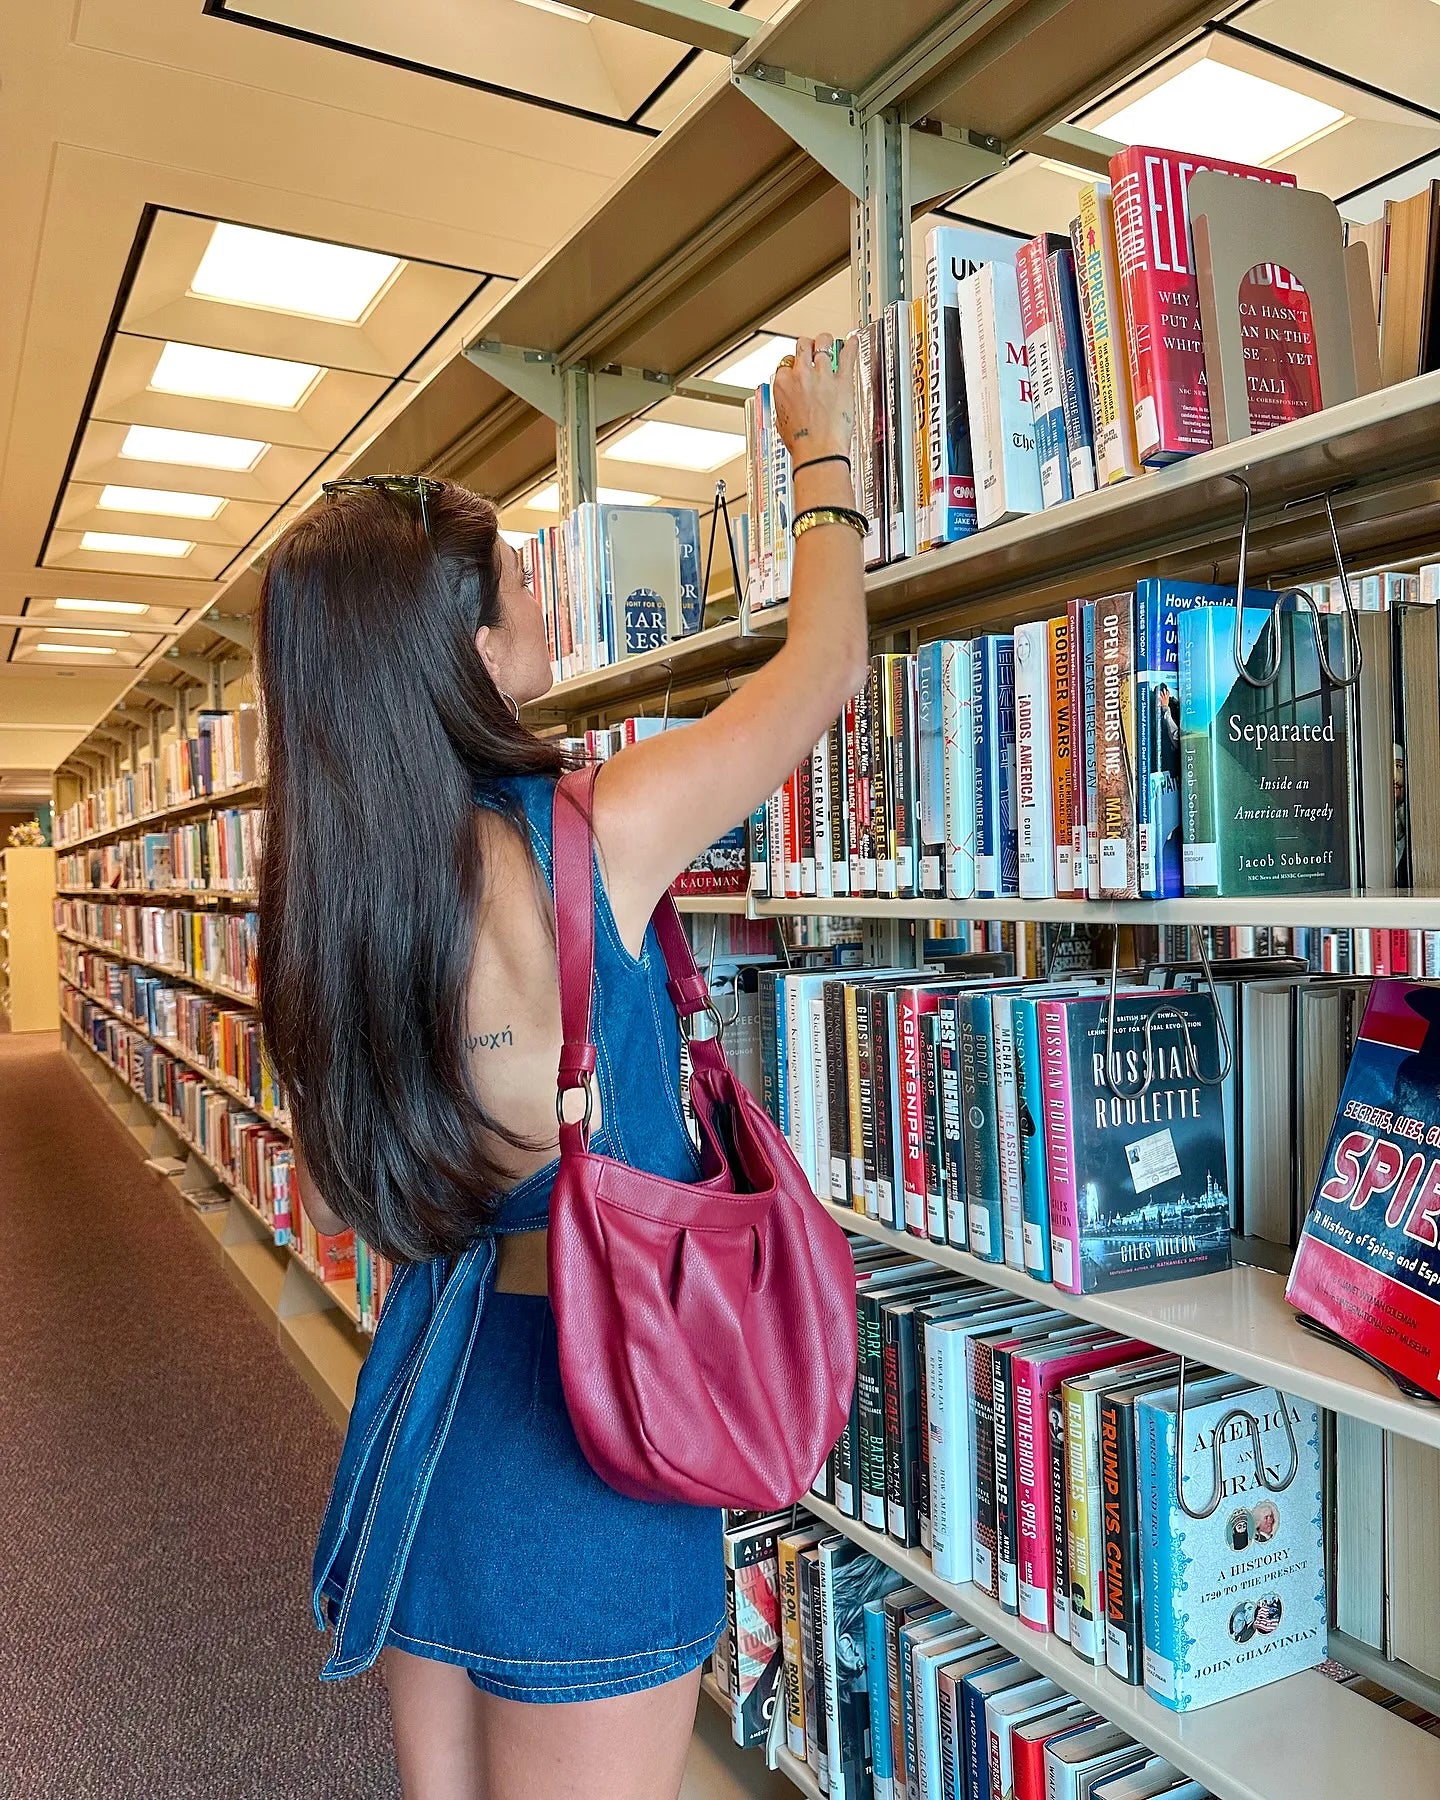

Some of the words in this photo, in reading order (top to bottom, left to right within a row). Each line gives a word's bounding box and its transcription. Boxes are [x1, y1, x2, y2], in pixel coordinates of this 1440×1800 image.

[1018, 257, 1033, 329] O'DONNELL
[1086, 250, 1110, 338] REPRESENT
[1158, 291, 1190, 308] WHY
[1161, 314, 1188, 329] PUT
[1261, 305, 1308, 323] HASN'T
[1265, 328, 1280, 340] IN
[1283, 330, 1312, 345] THE
[926, 256, 943, 474] UNPRECEDENTED
[1028, 343, 1038, 377] WITH
[1040, 342, 1053, 396] PLAYING
[1286, 352, 1313, 366] YET
[1032, 381, 1041, 411] FIRE
[1066, 368, 1076, 392] HOW
[1069, 394, 1079, 417] THE
[1012, 432, 1035, 451] The
[1072, 417, 1083, 445] HELL
[953, 517, 970, 526] JAKE
[1165, 593, 1193, 608] How
[1194, 595, 1234, 608] Should
[1103, 614, 1119, 662] OPEN
[1055, 626, 1068, 701] BORDER
[1085, 652, 1095, 673] WE
[1184, 641, 1196, 715] Separated
[920, 666, 933, 722] Lucky
[972, 650, 984, 745] ENDPAPERS
[1085, 675, 1095, 700] ARE
[1103, 664, 1121, 744] BORDERS
[873, 721, 881, 761] GREEN
[1057, 706, 1071, 759] WARS
[1086, 704, 1096, 738] HERE
[1228, 714, 1336, 751] Separated
[1086, 741, 1096, 756] TO
[1185, 749, 1198, 787] Jacob
[831, 754, 840, 801] DESTROY
[874, 770, 884, 799] THE
[975, 766, 984, 823] ALEXANDER
[1020, 745, 1036, 808] AMERICA!
[1087, 759, 1098, 790] STAY
[1259, 776, 1293, 790] Inside
[1295, 780, 1310, 790] an
[802, 774, 812, 845] BARGAIN
[814, 755, 824, 839] CYBERWAR
[1234, 806, 1289, 820] American
[1293, 803, 1335, 821] Tragedy
[755, 822, 765, 853] END
[849, 809, 858, 849] AMERICA
[875, 805, 887, 860] REBELS
[1238, 854, 1276, 872] Jacob
[1280, 850, 1334, 866] Soboroff
[1260, 874, 1272, 882] News
[1272, 873, 1280, 881] and
[680, 876, 740, 890] KAUFMAN
[813, 1013, 822, 1054] Richard
[857, 1006, 868, 1057] GHOSTS
[903, 1004, 916, 1079] AGENT
[940, 1009, 956, 1051] BEST
[1128, 1025, 1141, 1033] FOR
[790, 1027, 800, 1081] Kissinger
[875, 1035, 885, 1092] SECRET
[926, 1043, 934, 1076] SPIES
[962, 1022, 975, 1095] SECRETS
[975, 1034, 987, 1067] BODY
[1001, 1028, 1013, 1086] MICHAEL
[1015, 1011, 1027, 1092] POISONER
[1045, 1012, 1065, 1090] RUSSIAN
[815, 1057, 823, 1089] Haass
[927, 1079, 935, 1096] OF
[977, 1071, 988, 1087] OF
[793, 1084, 801, 1119] World
[860, 1079, 873, 1149] HONOLULU
[906, 1081, 919, 1160] SNIPER
[942, 1069, 960, 1142] ENEMIES
[1095, 1087, 1202, 1130] ROULETTE
[1343, 1100, 1394, 1134] SECRETS,
[1393, 1115, 1426, 1144] LIES,
[877, 1099, 886, 1146] STATE
[1050, 1098, 1070, 1186] ROULETTE
[973, 1138, 982, 1172] JAMES
[1006, 1132, 1019, 1189] ASSAULT
[1319, 1130, 1440, 1248] SPIE
[1120, 1242, 1151, 1263] GILES
[1154, 1233, 1196, 1258] MILTON
[1312, 1210, 1320, 1224] A
[1320, 1213, 1354, 1245] History
[1355, 1233, 1367, 1248] of
[1366, 1237, 1396, 1261] Spies
[1396, 1254, 1420, 1272] and
[856, 1308, 867, 1365] MIRROR
[1384, 1304, 1418, 1329] COLEMAN
[866, 1320, 881, 1359] DARK
[1384, 1323, 1400, 1339] SPY
[1399, 1333, 1432, 1358] MUSEUM
[884, 1346, 898, 1391] WISE
[994, 1359, 1002, 1375] THE
[885, 1394, 899, 1436] GALS
[994, 1379, 1006, 1449] MOSCOW
[1068, 1401, 1082, 1437] DEAD
[1193, 1405, 1302, 1453] AMERICA
[1016, 1386, 1036, 1487] BROTHERHOOD
[1101, 1407, 1120, 1496] TRUMP
[1148, 1415, 1159, 1483] AMERICA
[869, 1434, 885, 1491] BARTON
[996, 1452, 1008, 1506] RULES
[1069, 1441, 1086, 1502] DOUBLES
[1221, 1464, 1281, 1499] IRAN
[1021, 1499, 1038, 1540] SPIES
[1053, 1456, 1064, 1543] KISSINGER'S
[1104, 1501, 1121, 1537] VS.
[1151, 1514, 1160, 1548] IRAN
[1076, 1535, 1087, 1576] TREVOR
[1151, 1558, 1161, 1591] JOHN
[1217, 1570, 1226, 1582] A
[1230, 1547, 1291, 1578] HISTORY
[785, 1560, 796, 1597] WAR
[1106, 1541, 1124, 1621] CHINA
[1200, 1590, 1222, 1604] 1720
[1223, 1584, 1239, 1596] TO
[1240, 1576, 1262, 1590] THE
[1264, 1560, 1309, 1583] PRESENT
[786, 1599, 797, 1621] ON
[813, 1585, 821, 1617] READ
[821, 1589, 829, 1626] WALKER
[815, 1639, 823, 1667] PINS
[903, 1641, 913, 1682] CODE
[1194, 1657, 1232, 1679] JOHN
[1236, 1626, 1319, 1664] GHAZVINIAN
[789, 1662, 801, 1717] RONAN
[823, 1661, 834, 1721] HILLARY
[915, 1674, 925, 1720] FOLLY
[904, 1690, 916, 1774] WARRIORS
[938, 1690, 953, 1745] CHAOS
[969, 1709, 980, 1778] AVOIDABLE
[991, 1736, 999, 1755] ONE
[1048, 1765, 1056, 1787] WHAT
